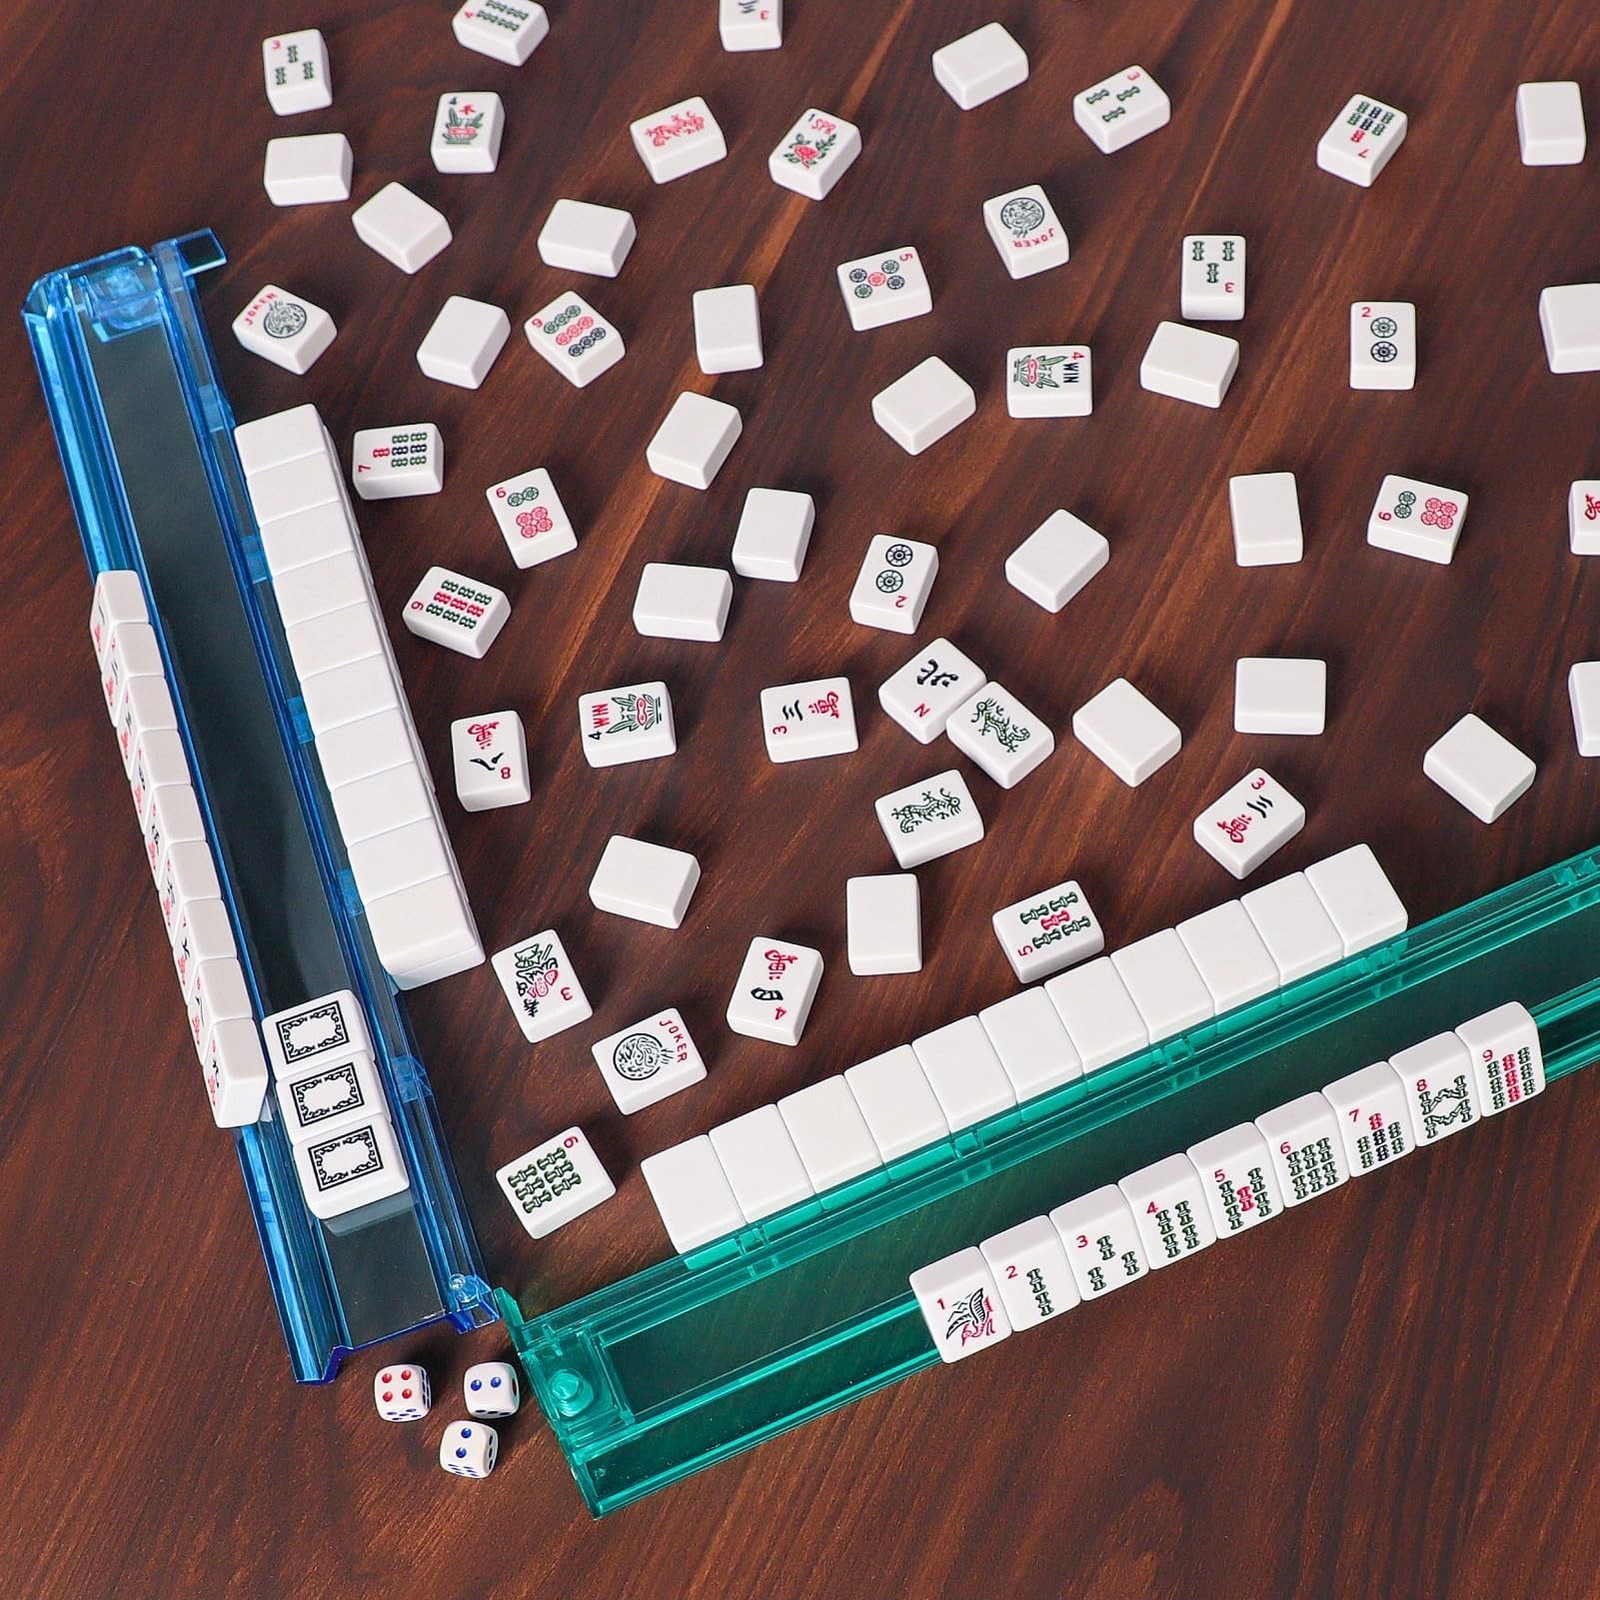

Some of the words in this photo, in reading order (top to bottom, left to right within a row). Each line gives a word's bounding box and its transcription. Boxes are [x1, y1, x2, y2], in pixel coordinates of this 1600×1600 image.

[271, 38, 282, 50] 3
[1127, 70, 1142, 82] 3
[805, 112, 816, 123] 1
[811, 118, 838, 135] SPR
[1357, 148, 1369, 159] 7
[1013, 226, 1055, 248] JOKER
[899, 251, 914, 262] 5
[1224, 281, 1235, 293] 3
[244, 291, 277, 326] JOKER
[1361, 305, 1372, 319] 2
[530, 316, 544, 329] 9
[1071, 350, 1086, 361] 4
[1062, 361, 1080, 385] WIN
[357, 463, 372, 474] 7
[495, 486, 507, 500] 6
[1378, 510, 1393, 522] 6
[410, 599, 426, 612] 9
[895, 594, 909, 609] 2
[916, 658, 959, 688] 北
[591, 702, 611, 730] WIN
[912, 702, 932, 719] N
[587, 730, 603, 741] 4
[772, 724, 788, 735] 3
[499, 764, 513, 781] 8
[1251, 776, 1267, 791] 3
[1018, 944, 1034, 958] 5
[560, 986, 574, 1001] 3
[774, 1006, 788, 1021] 4
[658, 1018, 689, 1064] JOKER
[1481, 1049, 1495, 1064] 9
[1416, 1078, 1429, 1093] 8
[1348, 1108, 1362, 1123] 7
[563, 1135, 580, 1149] 6
[1279, 1141, 1292, 1155] 6
[1214, 1168, 1227, 1183] 5
[1146, 1200, 1160, 1215] 4
[1076, 1234, 1090, 1249] 3
[1005, 1264, 1019, 1279] 2
[936, 1296, 947, 1311] 1
